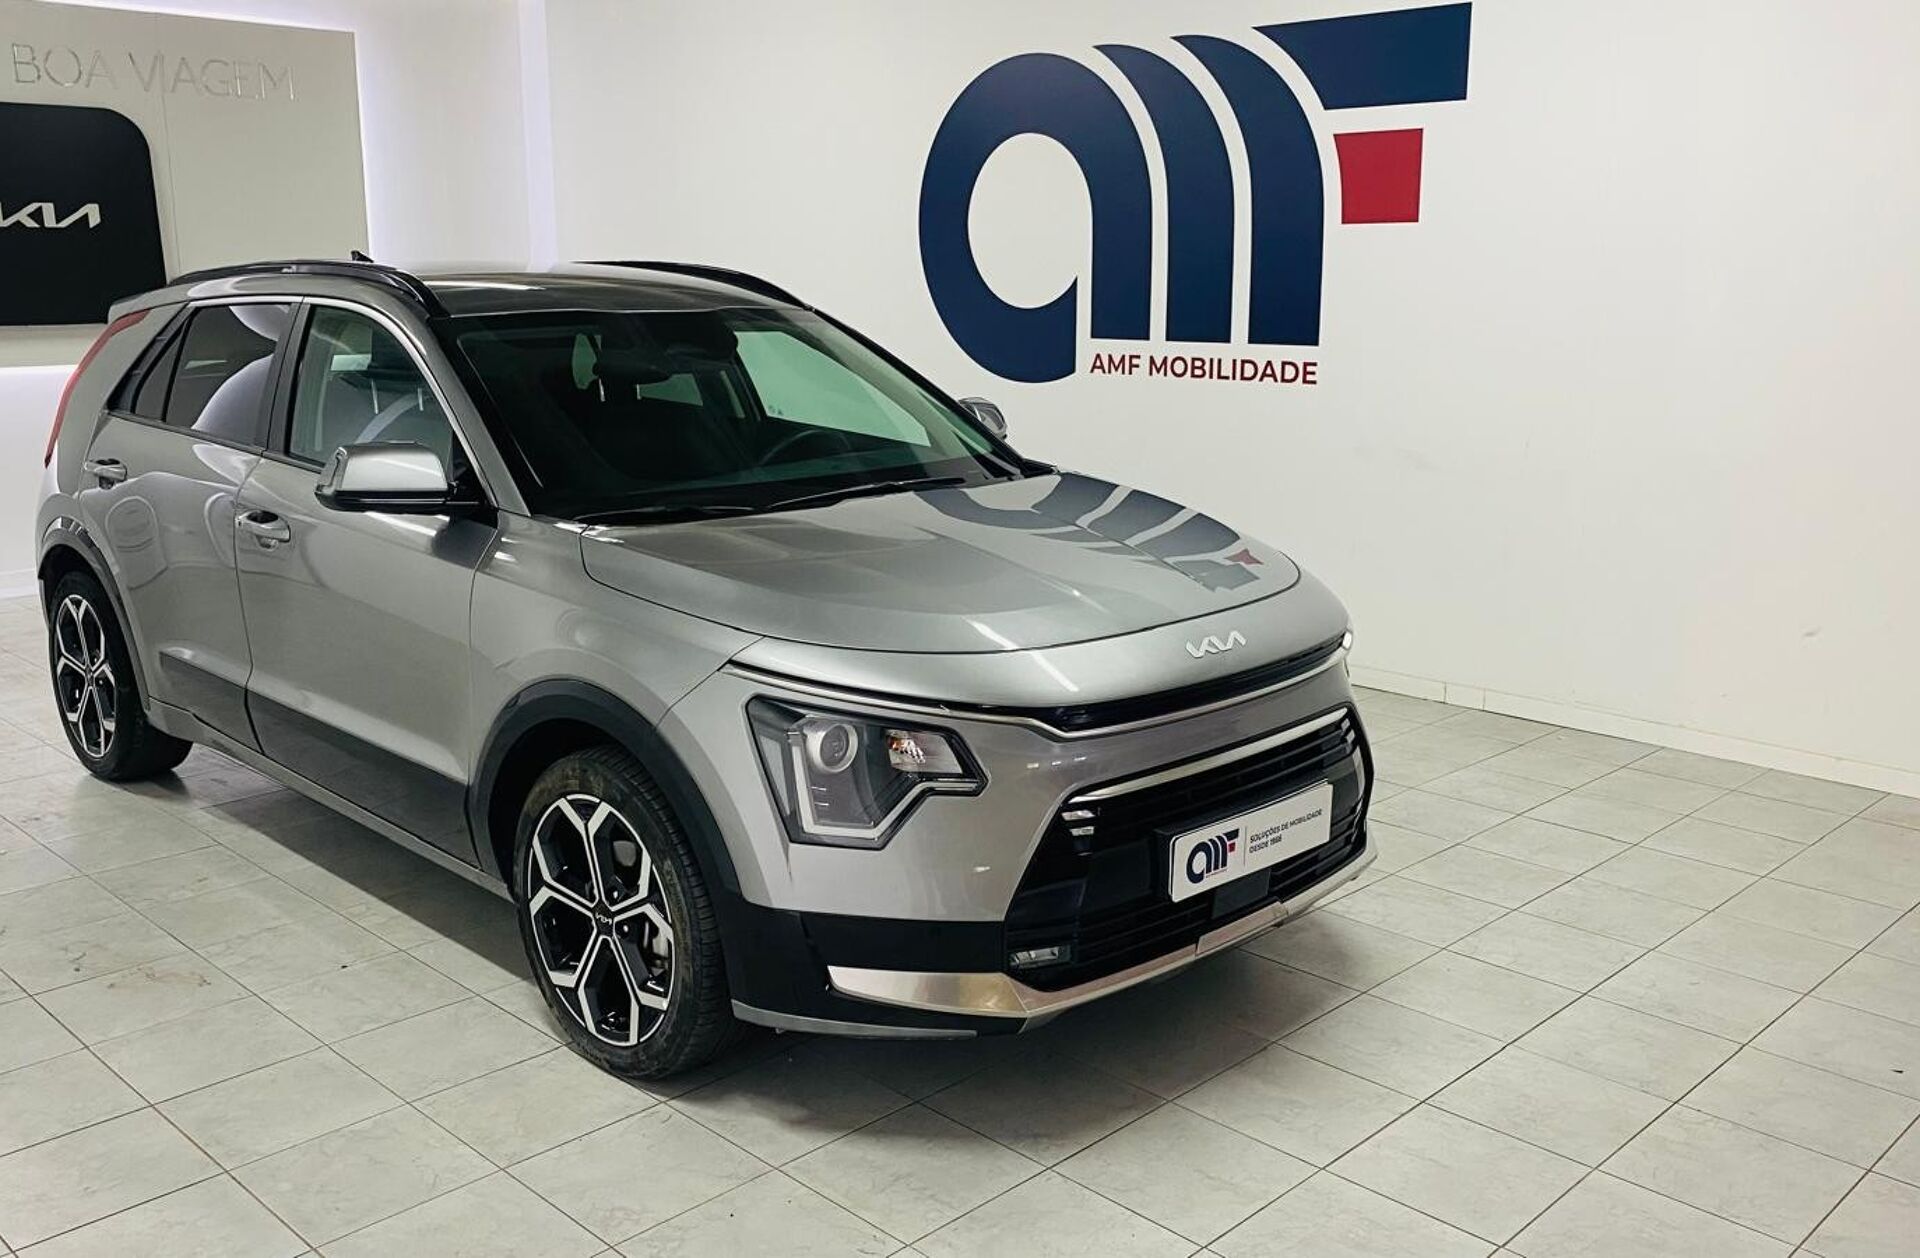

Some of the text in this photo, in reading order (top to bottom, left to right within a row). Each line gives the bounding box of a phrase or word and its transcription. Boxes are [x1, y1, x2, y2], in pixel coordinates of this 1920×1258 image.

[11, 43, 297, 101] BOA VIAGEM
[1090, 353, 1318, 385] AMF MOBILIDADE
[1185, 630, 1247, 659] KIA
[1289, 808, 1323, 828] MOBILIDADE
[1249, 840, 1269, 854] DESDE
